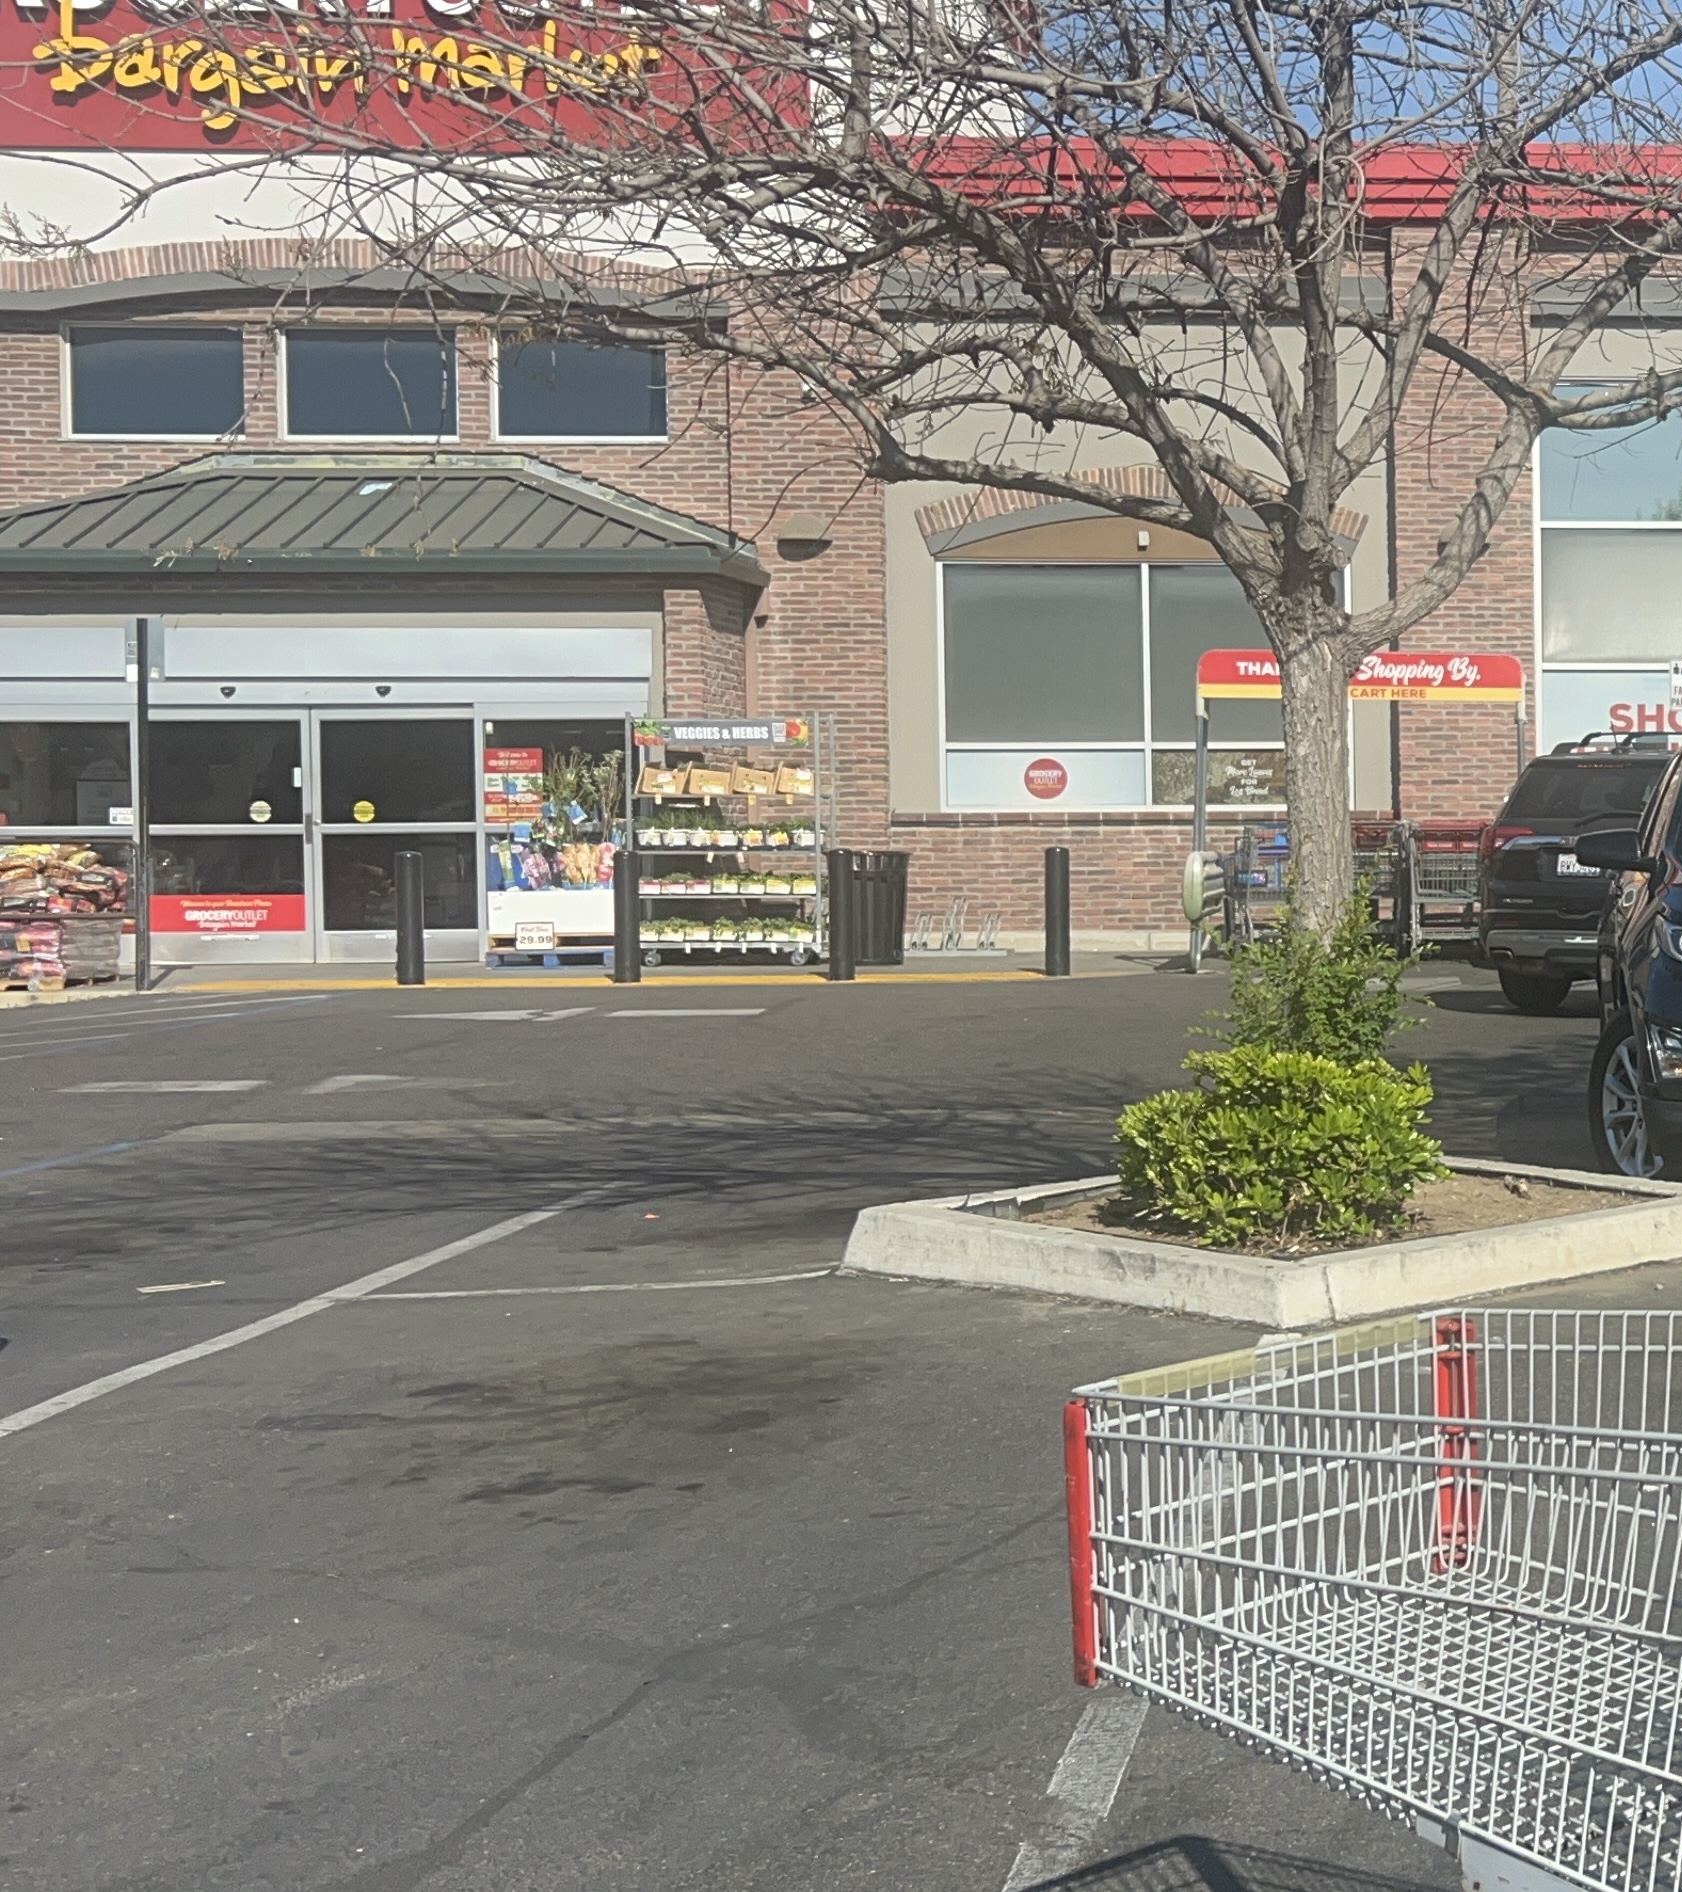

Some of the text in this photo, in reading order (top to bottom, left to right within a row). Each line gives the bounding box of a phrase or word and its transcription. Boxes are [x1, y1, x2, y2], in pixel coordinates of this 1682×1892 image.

[1357, 655, 1444, 686] Shopping
[1447, 656, 1481, 686] By.
[1350, 688, 1427, 698] CART HERE
[674, 726, 769, 740] VEGGIES & HERBS
